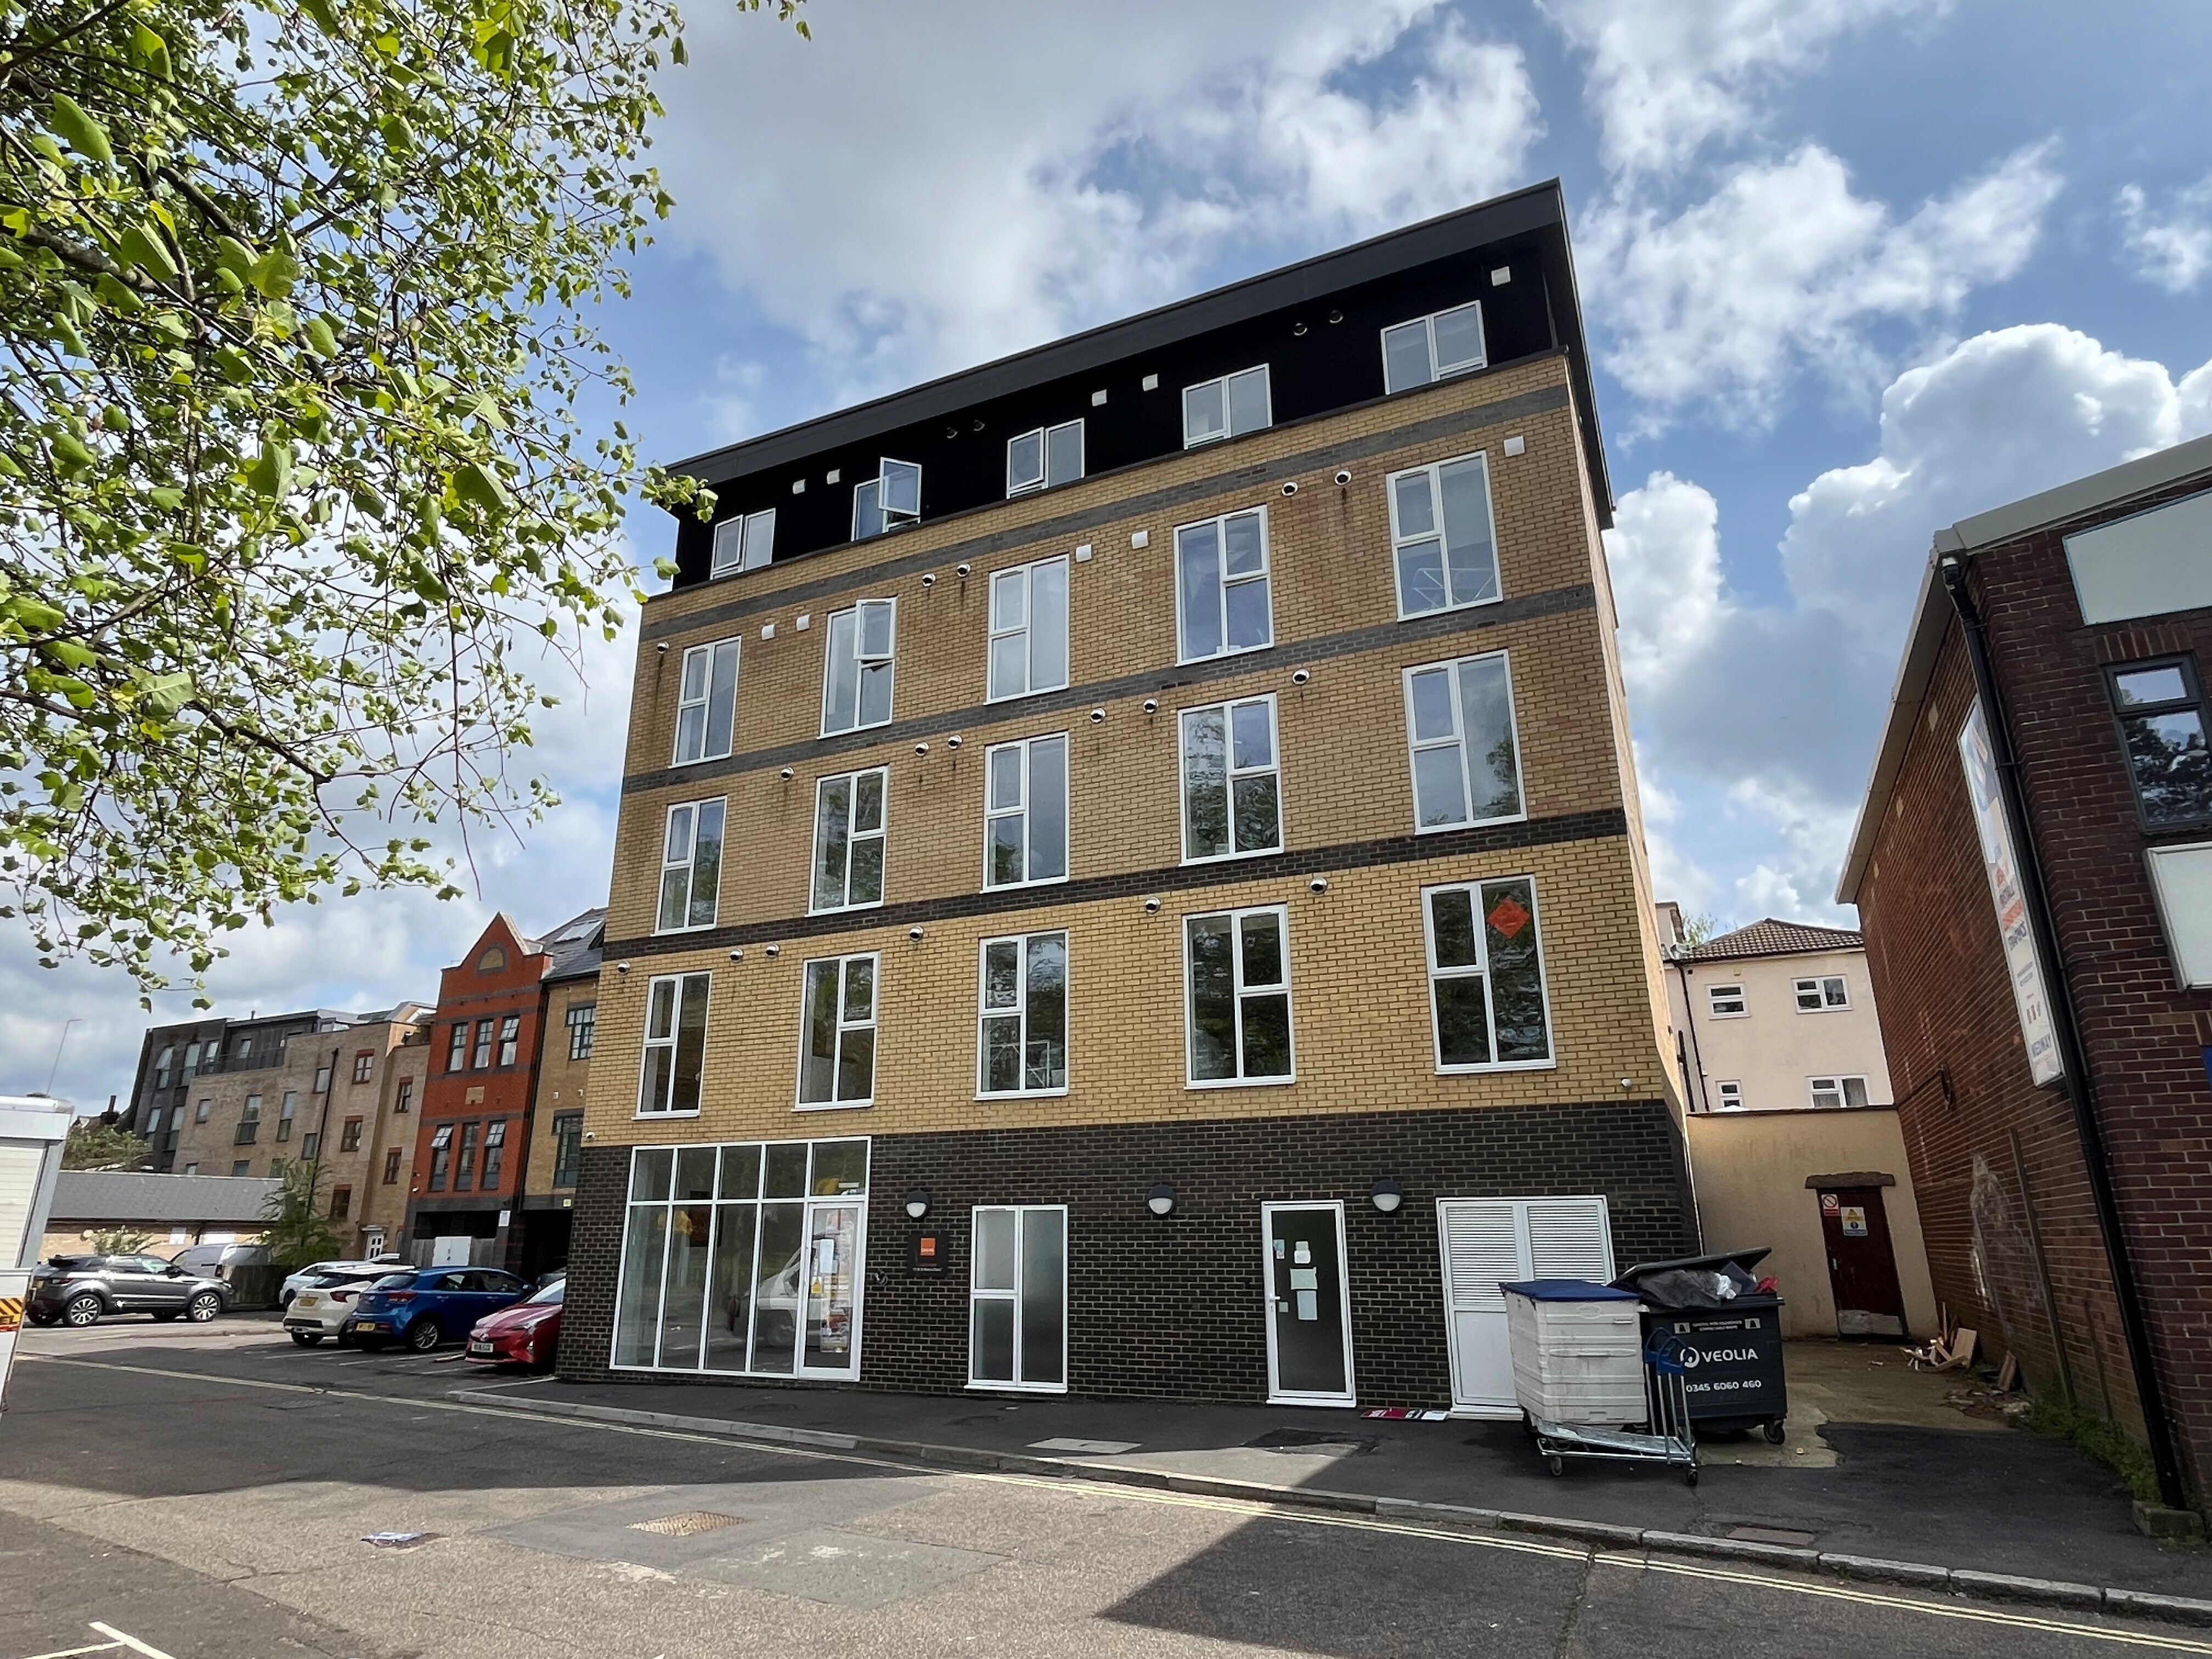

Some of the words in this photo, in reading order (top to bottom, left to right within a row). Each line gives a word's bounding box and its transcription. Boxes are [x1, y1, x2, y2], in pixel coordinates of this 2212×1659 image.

[1701, 1348, 1758, 1363] VEOLIA
[1686, 1383, 1711, 1392] 0345
[1714, 1381, 1739, 1390] 6060
[1742, 1380, 1762, 1388] 460
